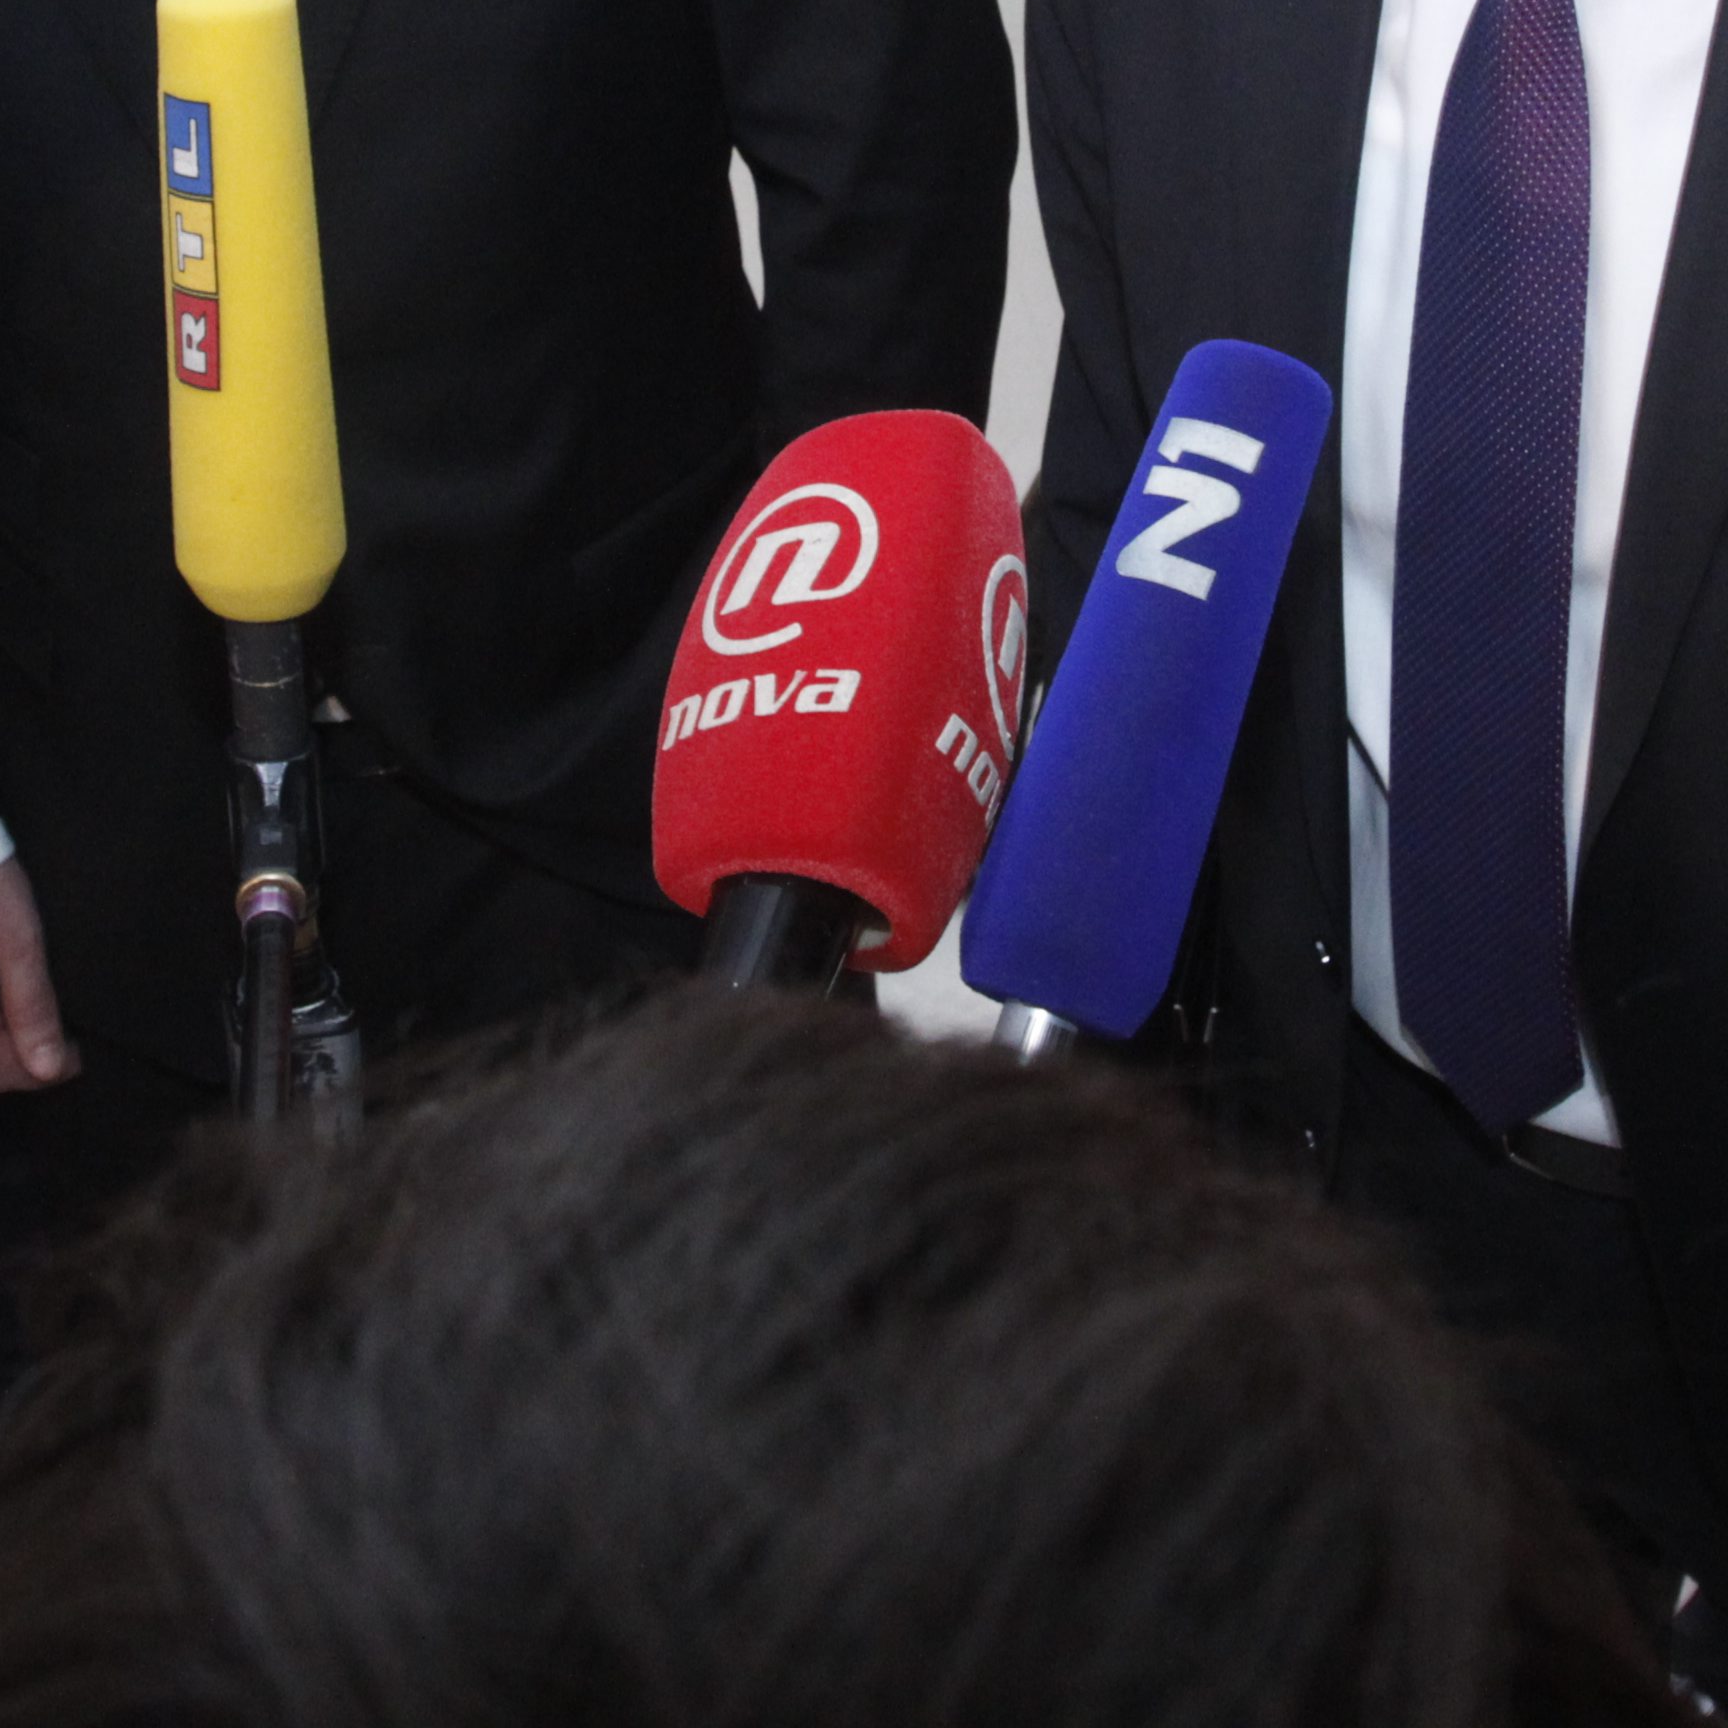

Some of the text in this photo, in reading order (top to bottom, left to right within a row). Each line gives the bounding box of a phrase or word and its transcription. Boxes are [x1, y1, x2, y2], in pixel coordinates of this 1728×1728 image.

[170, 114, 212, 378] RTL
[1115, 416, 1265, 601] N1
[661, 667, 862, 752] nova
